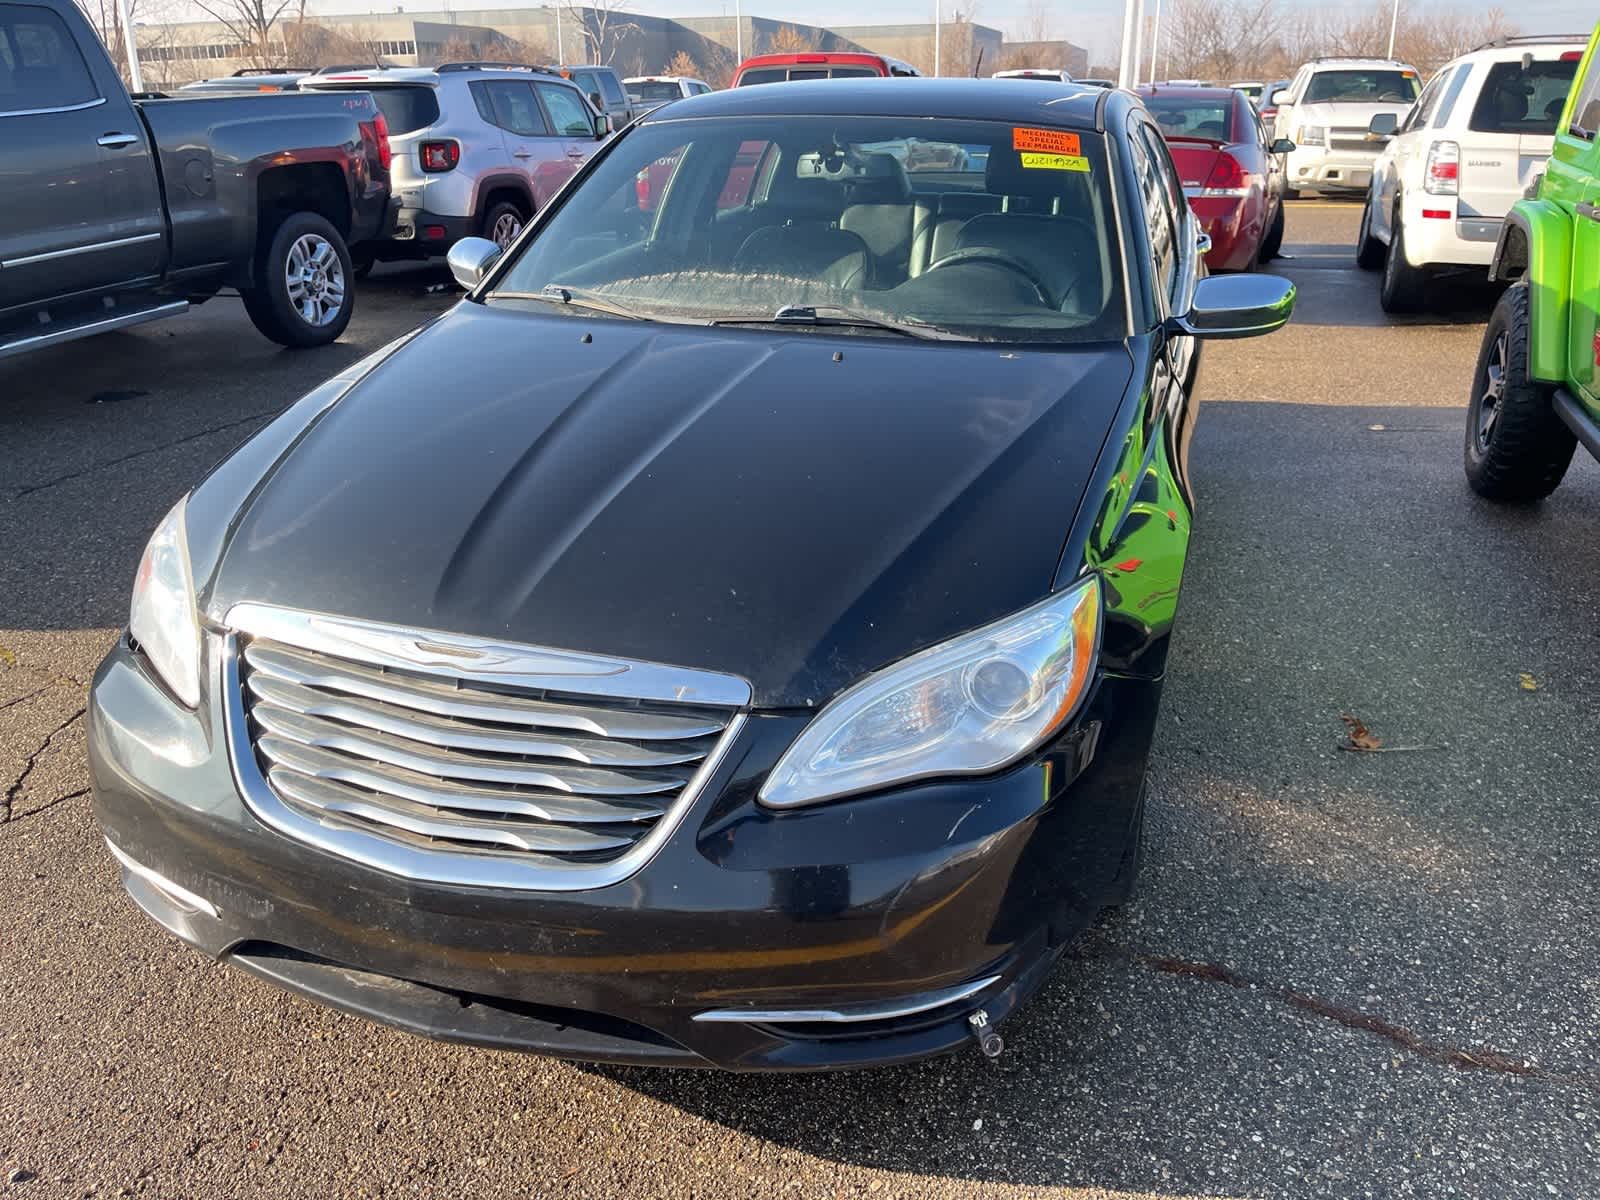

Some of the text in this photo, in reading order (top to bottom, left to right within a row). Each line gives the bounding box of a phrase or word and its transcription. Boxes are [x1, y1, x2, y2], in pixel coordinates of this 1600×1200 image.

[1021, 130, 1072, 141] MECHANICS
[1029, 136, 1065, 146] SPECIAL
[1016, 141, 1078, 153] SEE MANAGER
